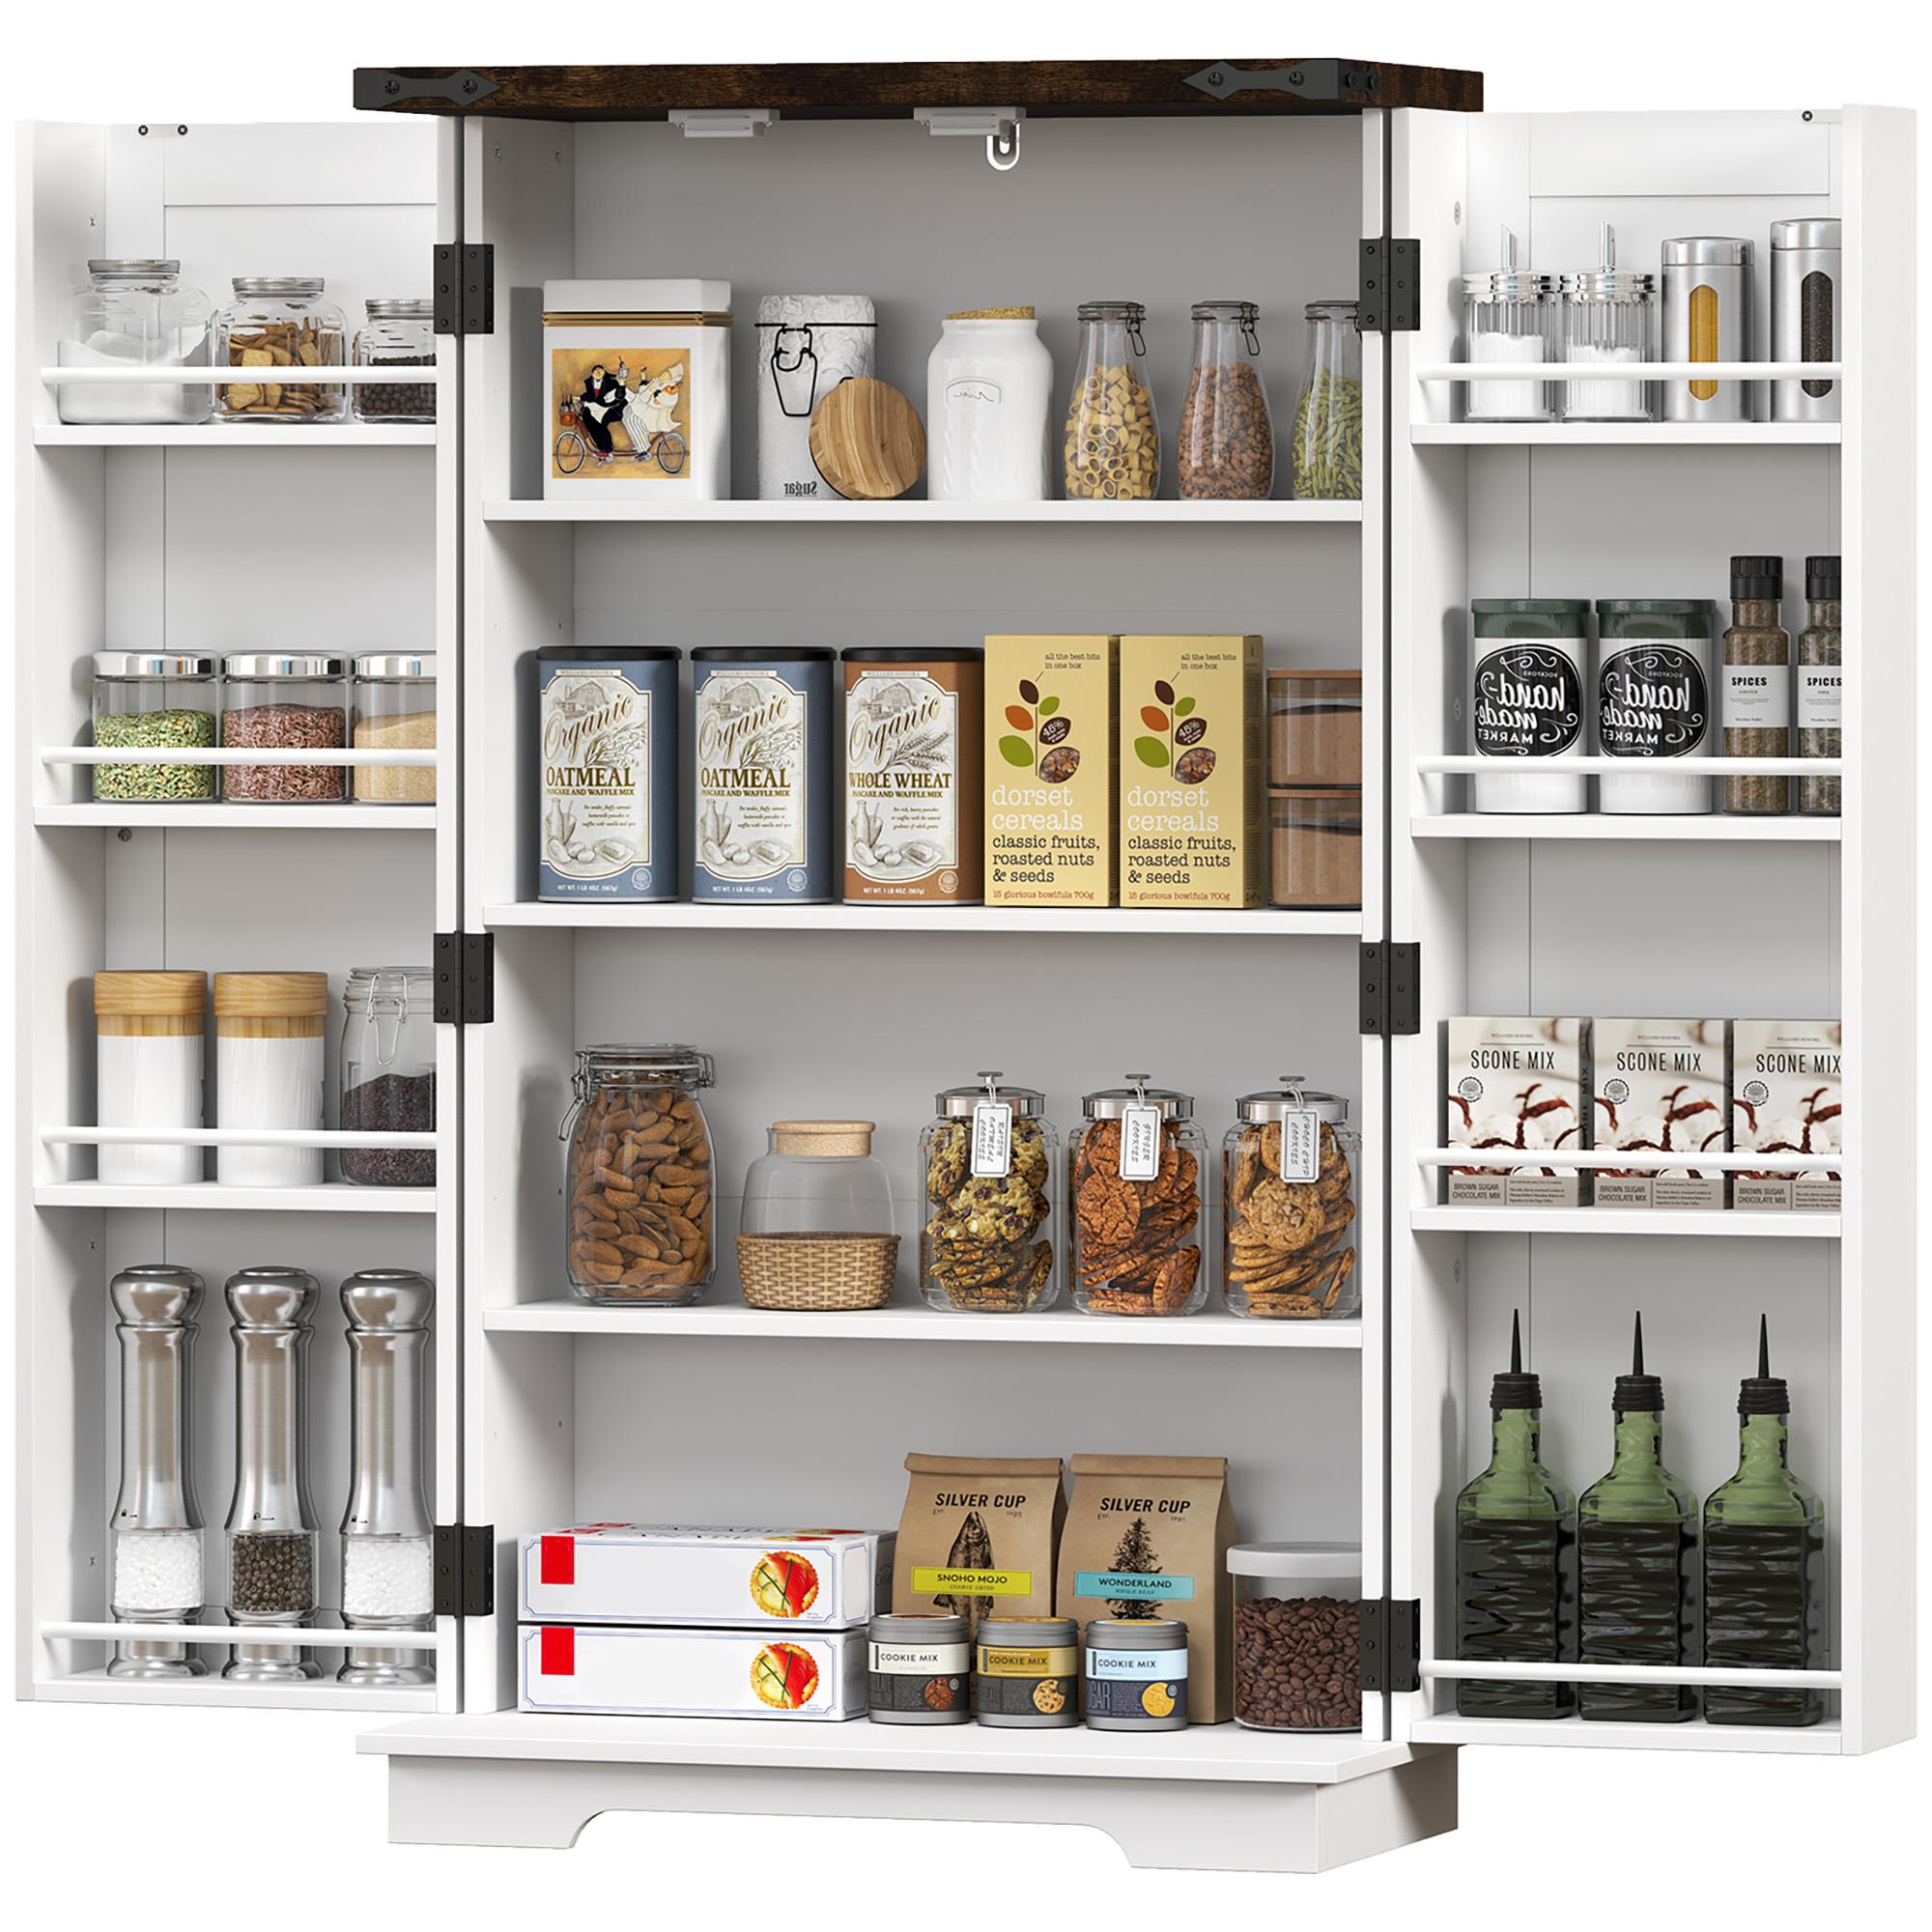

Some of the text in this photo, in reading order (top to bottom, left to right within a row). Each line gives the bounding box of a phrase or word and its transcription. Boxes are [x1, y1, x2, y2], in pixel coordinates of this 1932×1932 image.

[1731, 676, 1768, 687] SPICES
[1806, 676, 1842, 687] SPICES
[544, 694, 634, 764] Organic
[698, 694, 789, 765] Organic
[849, 694, 942, 769] Organic
[546, 767, 636, 787] OATMEAL
[701, 768, 791, 788] OATMEAL
[849, 773, 952, 789] WHOLE WHEAT
[992, 784, 1073, 807] dorset
[1127, 786, 1209, 809] dorset
[992, 810, 1083, 831] cereals
[1127, 812, 1219, 832] cereals
[993, 835, 1100, 851] classic fruits,
[1128, 836, 1236, 852] classic fruits,
[993, 852, 1094, 866] roasted nuts
[1128, 854, 1230, 867] roasted nuts
[993, 869, 1055, 883] & seeds
[1128, 870, 1190, 884] & seeds
[1470, 1050, 1555, 1069] SCONE MIX
[1616, 1052, 1701, 1072] SCONE MIX
[1756, 1054, 1841, 1074] SCONE MIX
[935, 1492, 1026, 1509] SILVER CUP
[1099, 1497, 1191, 1514] SILVER CUP
[937, 1574, 1008, 1584] SNOHO MOJO
[1098, 1578, 1173, 1589] WONDERLAND
[880, 1653, 939, 1662] COOKIE MIX
[988, 1655, 1048, 1666] COOKIE MIX
[1097, 1658, 1156, 1668] COOKIE MIX
